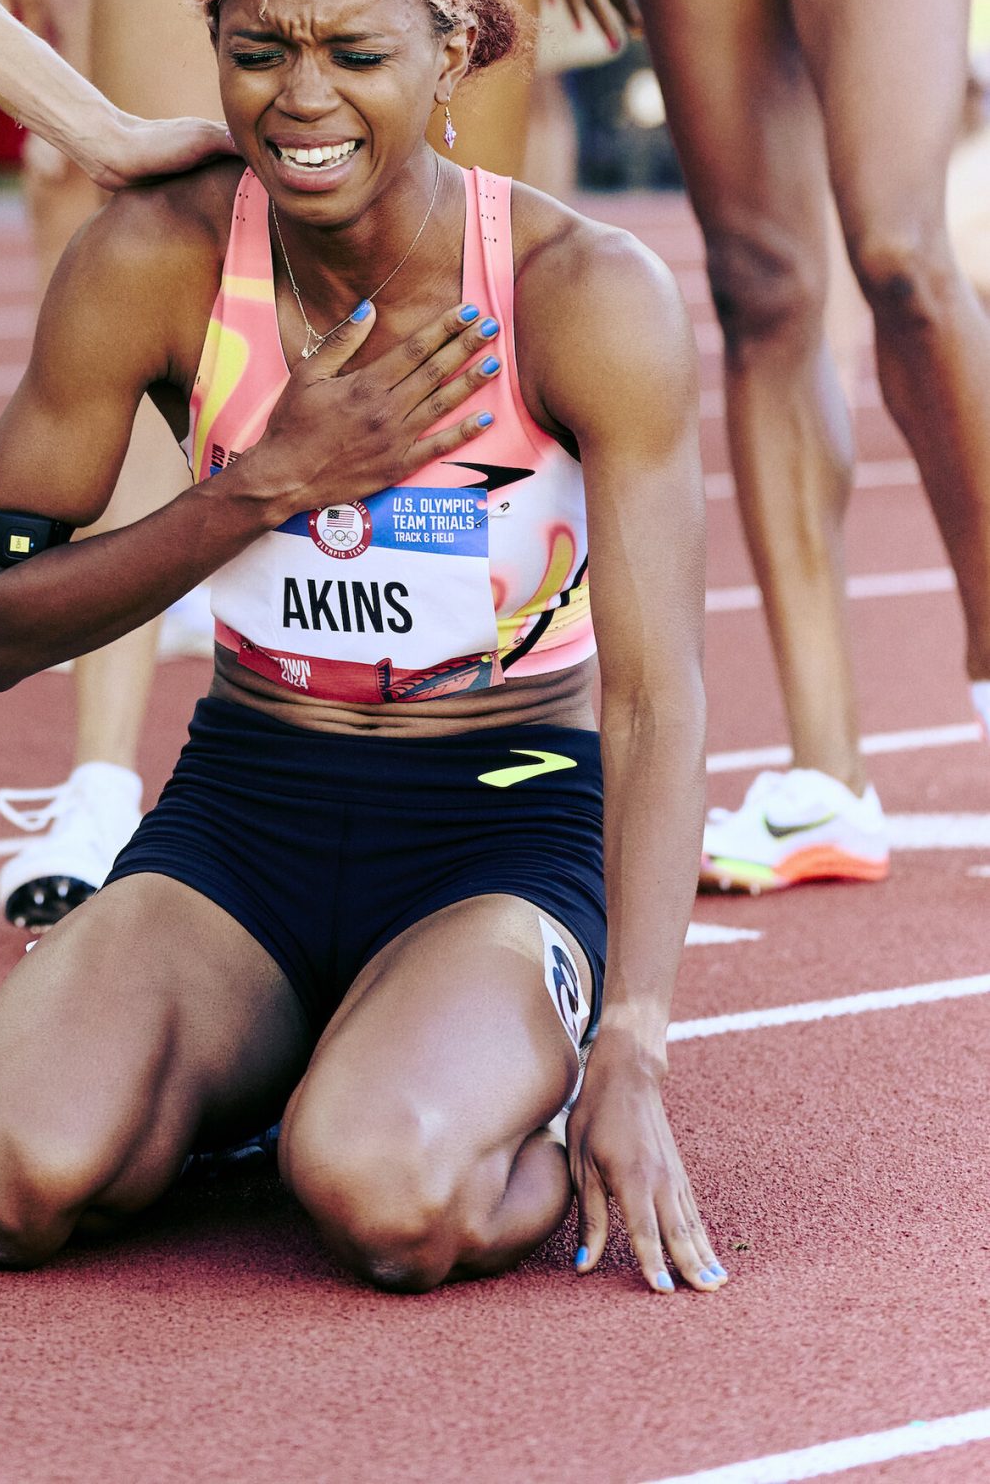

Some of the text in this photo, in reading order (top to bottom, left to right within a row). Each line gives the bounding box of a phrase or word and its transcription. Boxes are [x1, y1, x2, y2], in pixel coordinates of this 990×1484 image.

[393, 497, 475, 514] U.S. OLYMPIC
[392, 514, 475, 530] TEAM TRIALS
[394, 531, 455, 543] TRACK & FIELD
[316, 540, 366, 558] OLYMPIC TEAM
[283, 577, 413, 634] AKINS
